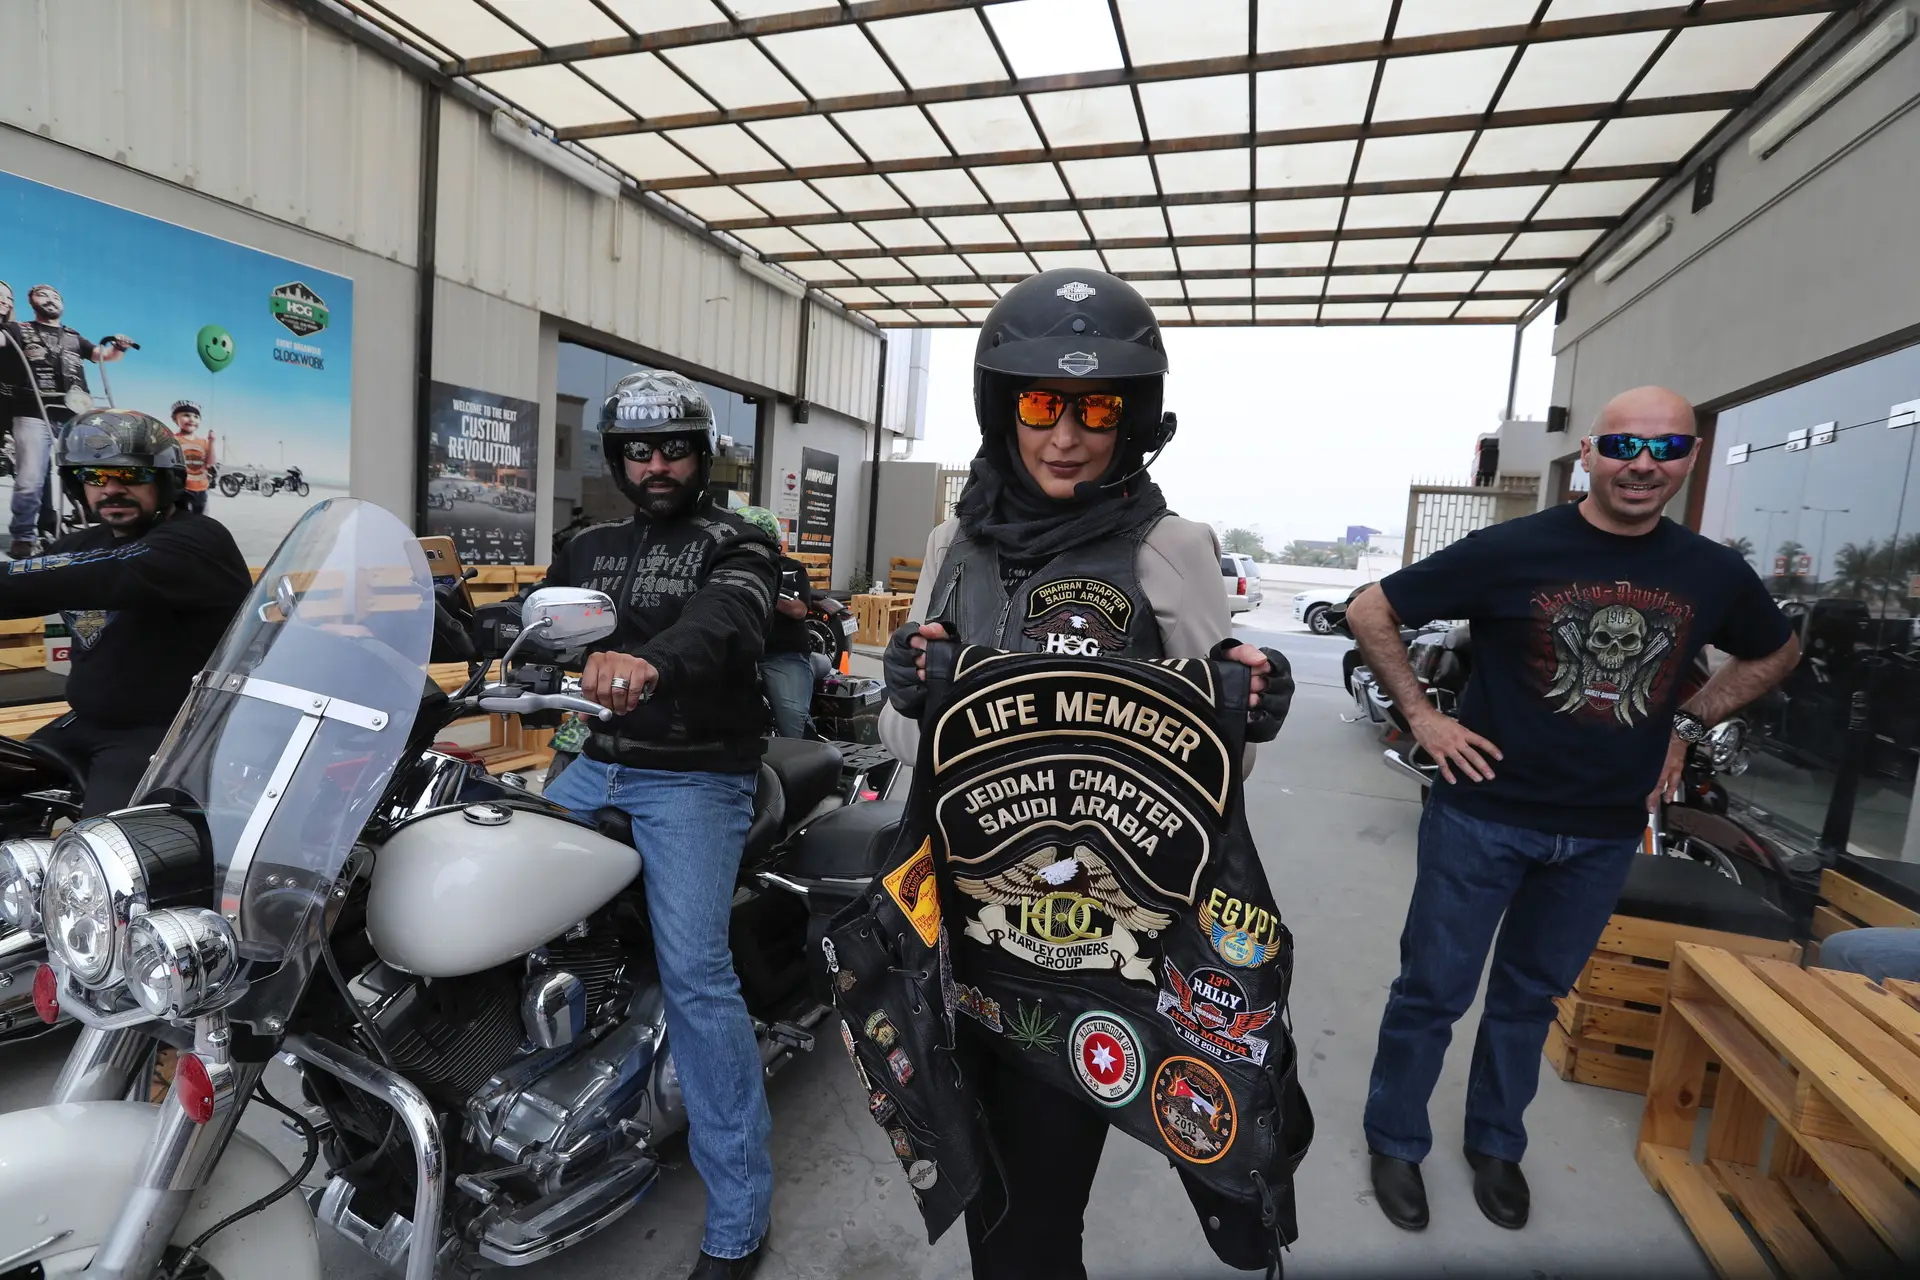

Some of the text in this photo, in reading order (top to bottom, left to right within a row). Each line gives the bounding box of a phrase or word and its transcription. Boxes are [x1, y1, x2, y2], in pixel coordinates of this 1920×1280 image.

[286, 301, 312, 317] HOG
[453, 399, 517, 421] WELCOME TO THE NEXT
[461, 415, 510, 443] CUSTOM
[448, 436, 520, 467] REVOLUTION
[1039, 582, 1127, 612] DHAHRAN CHAPTER
[1045, 591, 1115, 614] SAUDI ARABIA
[1606, 611, 1633, 625] 1903
[1045, 632, 1100, 657] HOG
[966, 691, 1200, 763] LIFE MEMBER
[965, 769, 1183, 838] JEDDAH CHAPTER
[978, 795, 1160, 857] SAUDI ARABIA
[1206, 887, 1278, 945] EGYPT
[1008, 928, 1109, 958] HARLEY OWNERS
[1034, 954, 1083, 969] GROUP
[1192, 977, 1242, 1010] RALLY
[1093, 1022, 1125, 1043] KINGDOM
[1184, 1030, 1200, 1046] UAE
[1201, 1030, 1248, 1056] MENA
[1121, 1041, 1132, 1051] OF
[1123, 1052, 1135, 1084] JORDAN
[1175, 1115, 1197, 1134] 2013
